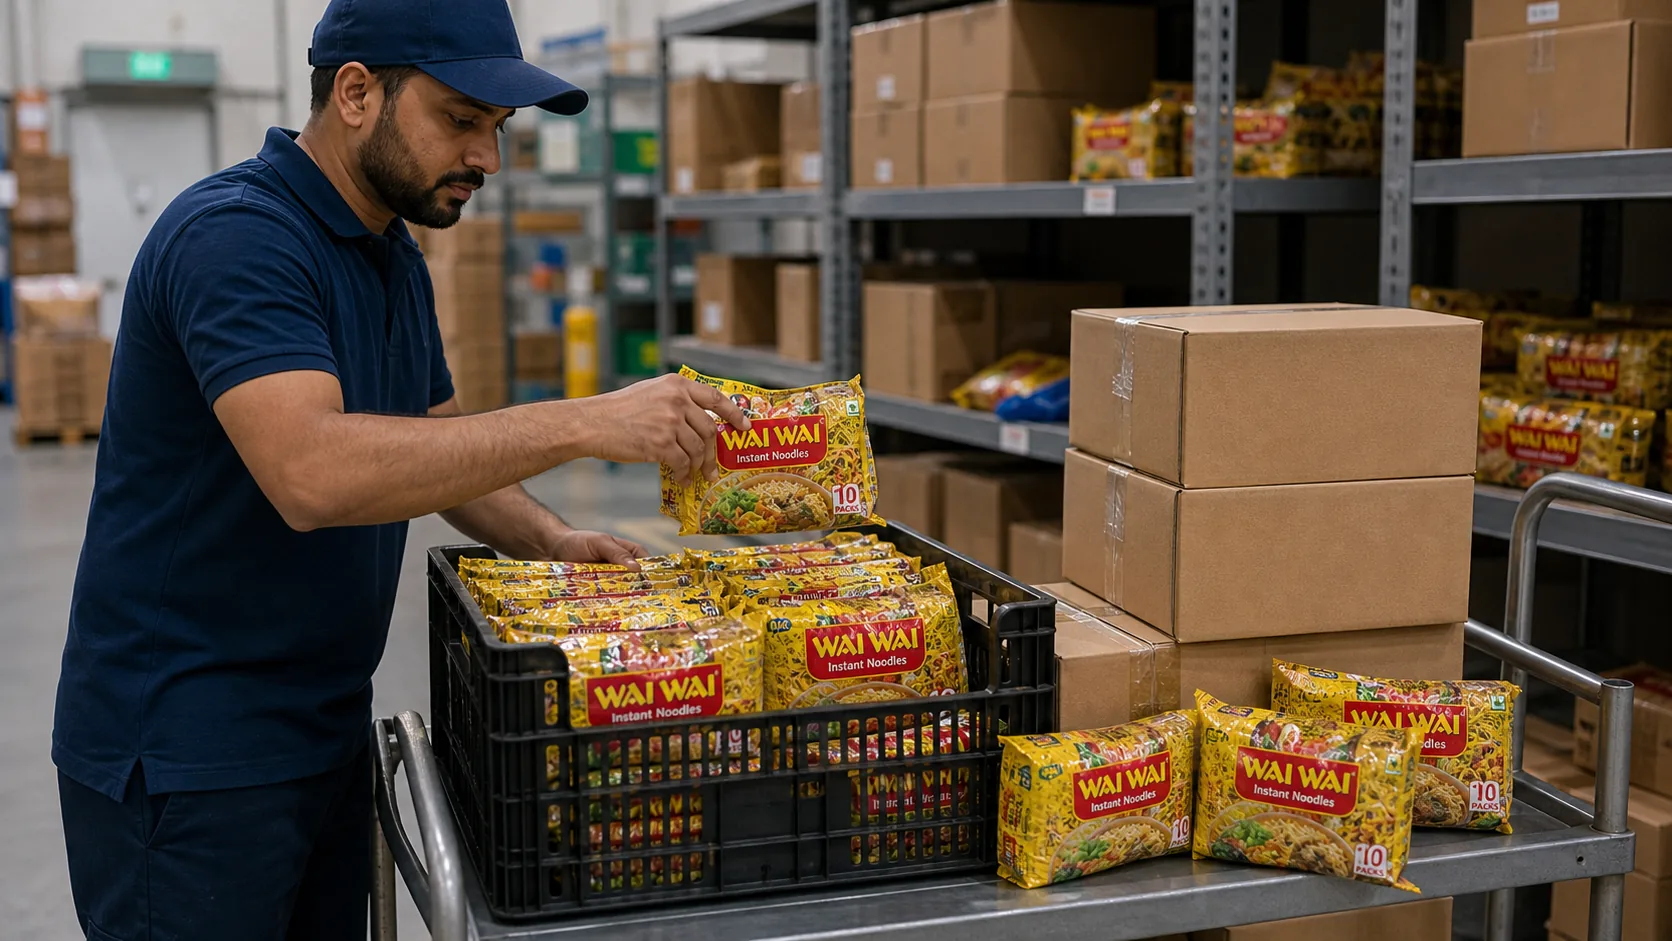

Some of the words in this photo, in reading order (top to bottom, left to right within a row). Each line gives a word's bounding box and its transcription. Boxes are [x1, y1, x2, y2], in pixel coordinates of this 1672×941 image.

[720, 427, 770, 450] WAI
[773, 422, 820, 446] WAI
[736, 452, 769, 463] Instant
[772, 449, 809, 461] Noodles
[833, 486, 857, 505] 10
[811, 633, 864, 658] WAI
[868, 627, 918, 653] WAI
[828, 660, 864, 672] Instant
[867, 656, 907, 668] Noodles
[594, 681, 654, 710] WAI
[659, 674, 715, 702] WAI
[612, 710, 652, 723] Instant
[655, 704, 702, 718] Noodles
[1350, 709, 1402, 729] WAI
[1407, 711, 1460, 735] WAI
[1078, 772, 1122, 800] WAI
[1125, 761, 1166, 789] WAI
[1242, 755, 1292, 785] WAI
[1297, 765, 1350, 794] WAI
[1091, 798, 1121, 812] Instant
[1123, 790, 1156, 805] Noodles
[1253, 784, 1289, 799] Instant
[1292, 790, 1335, 807] Noodles
[1472, 782, 1497, 801] 10
[1174, 818, 1189, 838] 10
[1357, 847, 1383, 867] 10
[1355, 866, 1384, 877] PACKS
